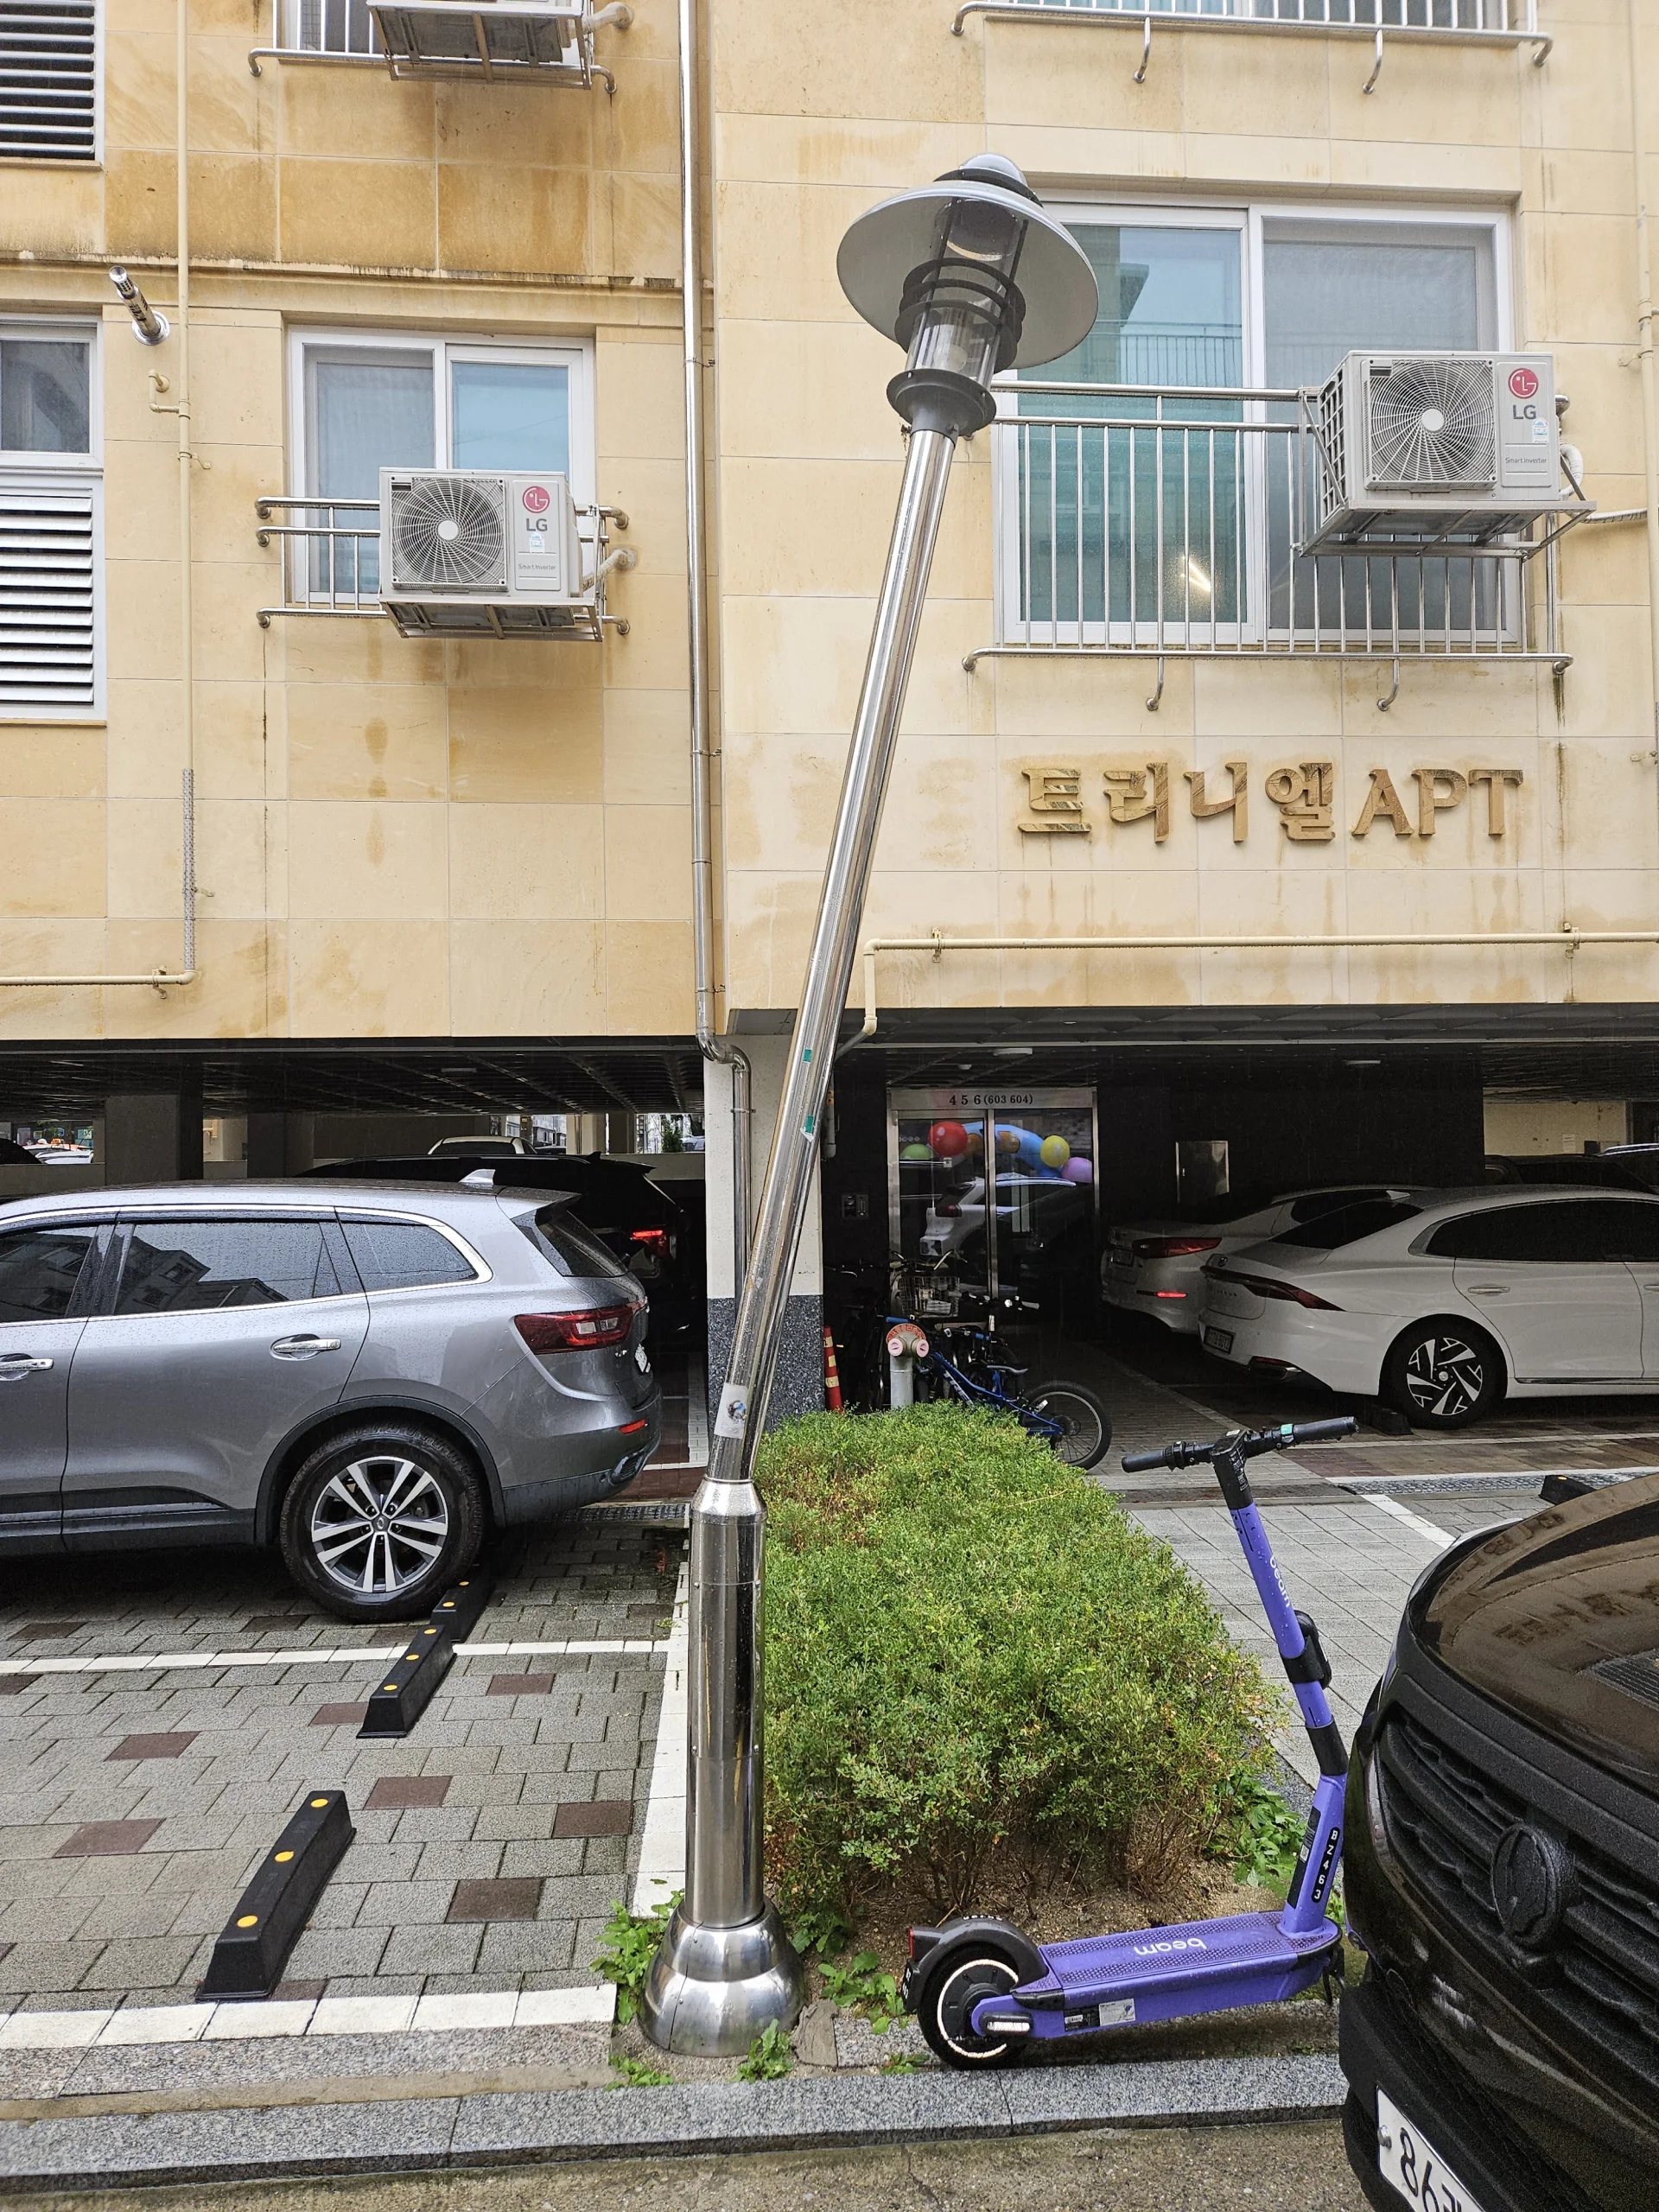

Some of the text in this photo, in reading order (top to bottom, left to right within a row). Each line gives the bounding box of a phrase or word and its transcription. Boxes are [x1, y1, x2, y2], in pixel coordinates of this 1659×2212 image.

[1512, 404, 1537, 420] LG
[525, 518, 548, 532] LG
[1017, 761, 1524, 844] 트리니엘 APT
[1269, 1554, 1291, 1608] beam
[1313, 1829, 1339, 1900] BZ463
[1133, 1937, 1208, 1955] beam
